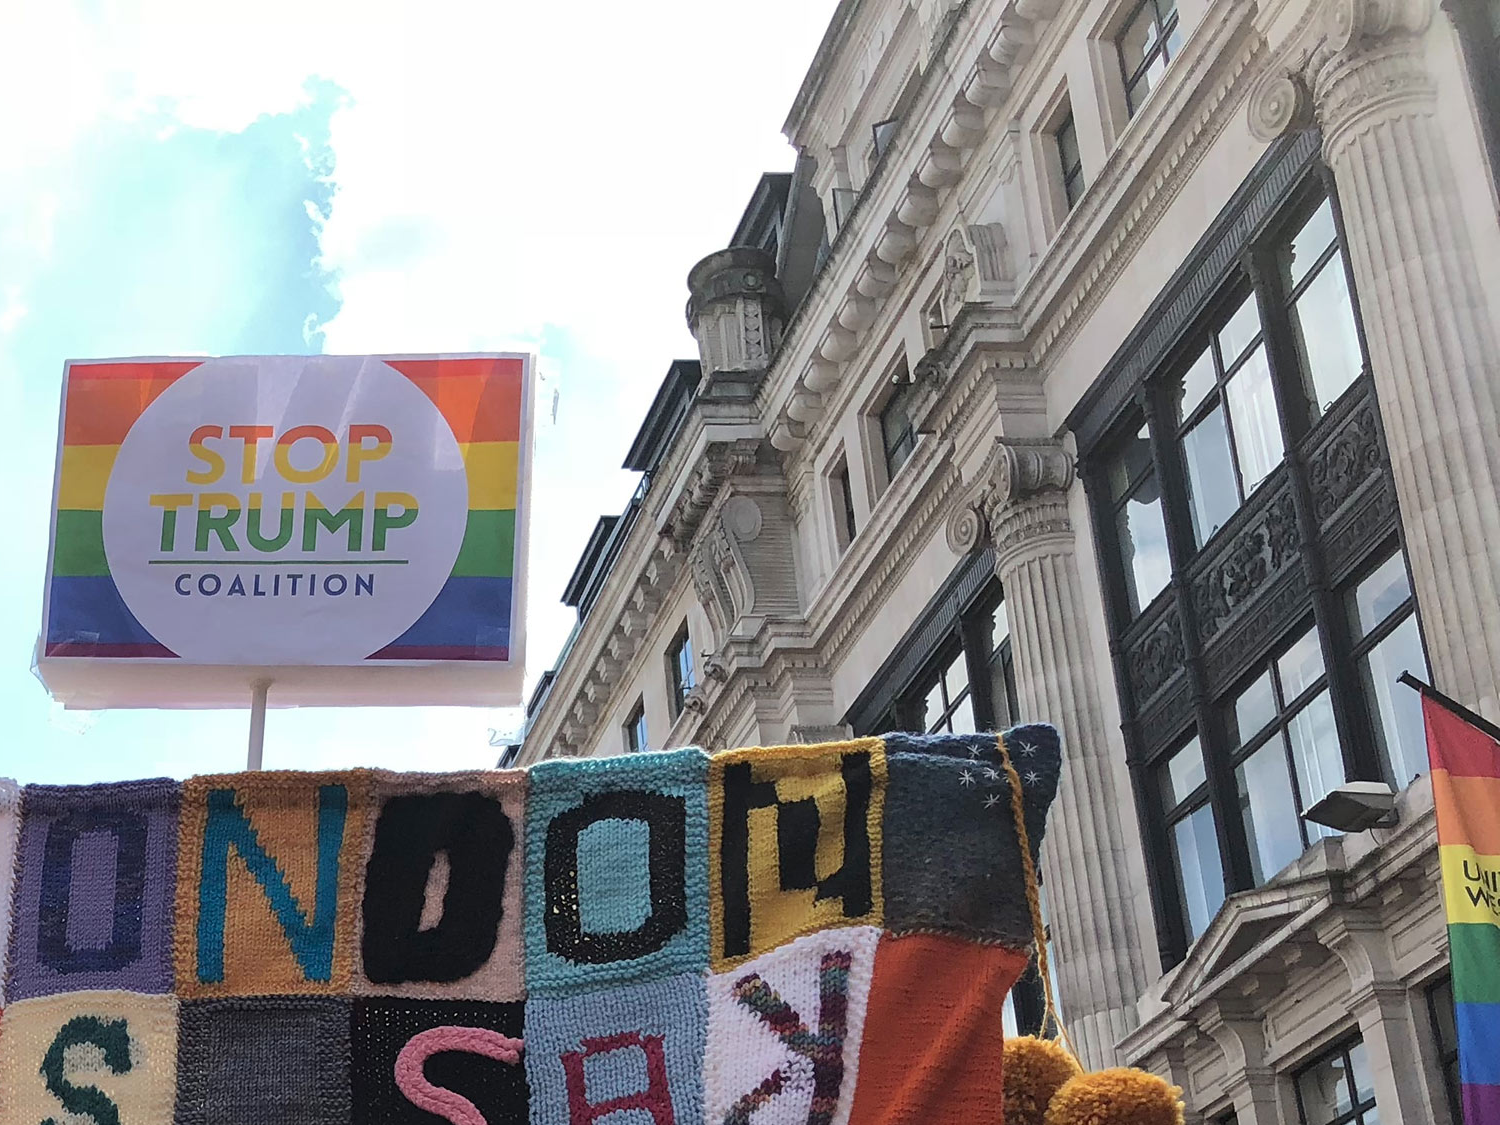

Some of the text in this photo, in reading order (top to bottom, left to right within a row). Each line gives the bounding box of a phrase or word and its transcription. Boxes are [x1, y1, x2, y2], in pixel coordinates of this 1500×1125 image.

[186, 424, 393, 485] STOP
[149, 491, 419, 553] TRUMP
[174, 573, 375, 596] COALITION
